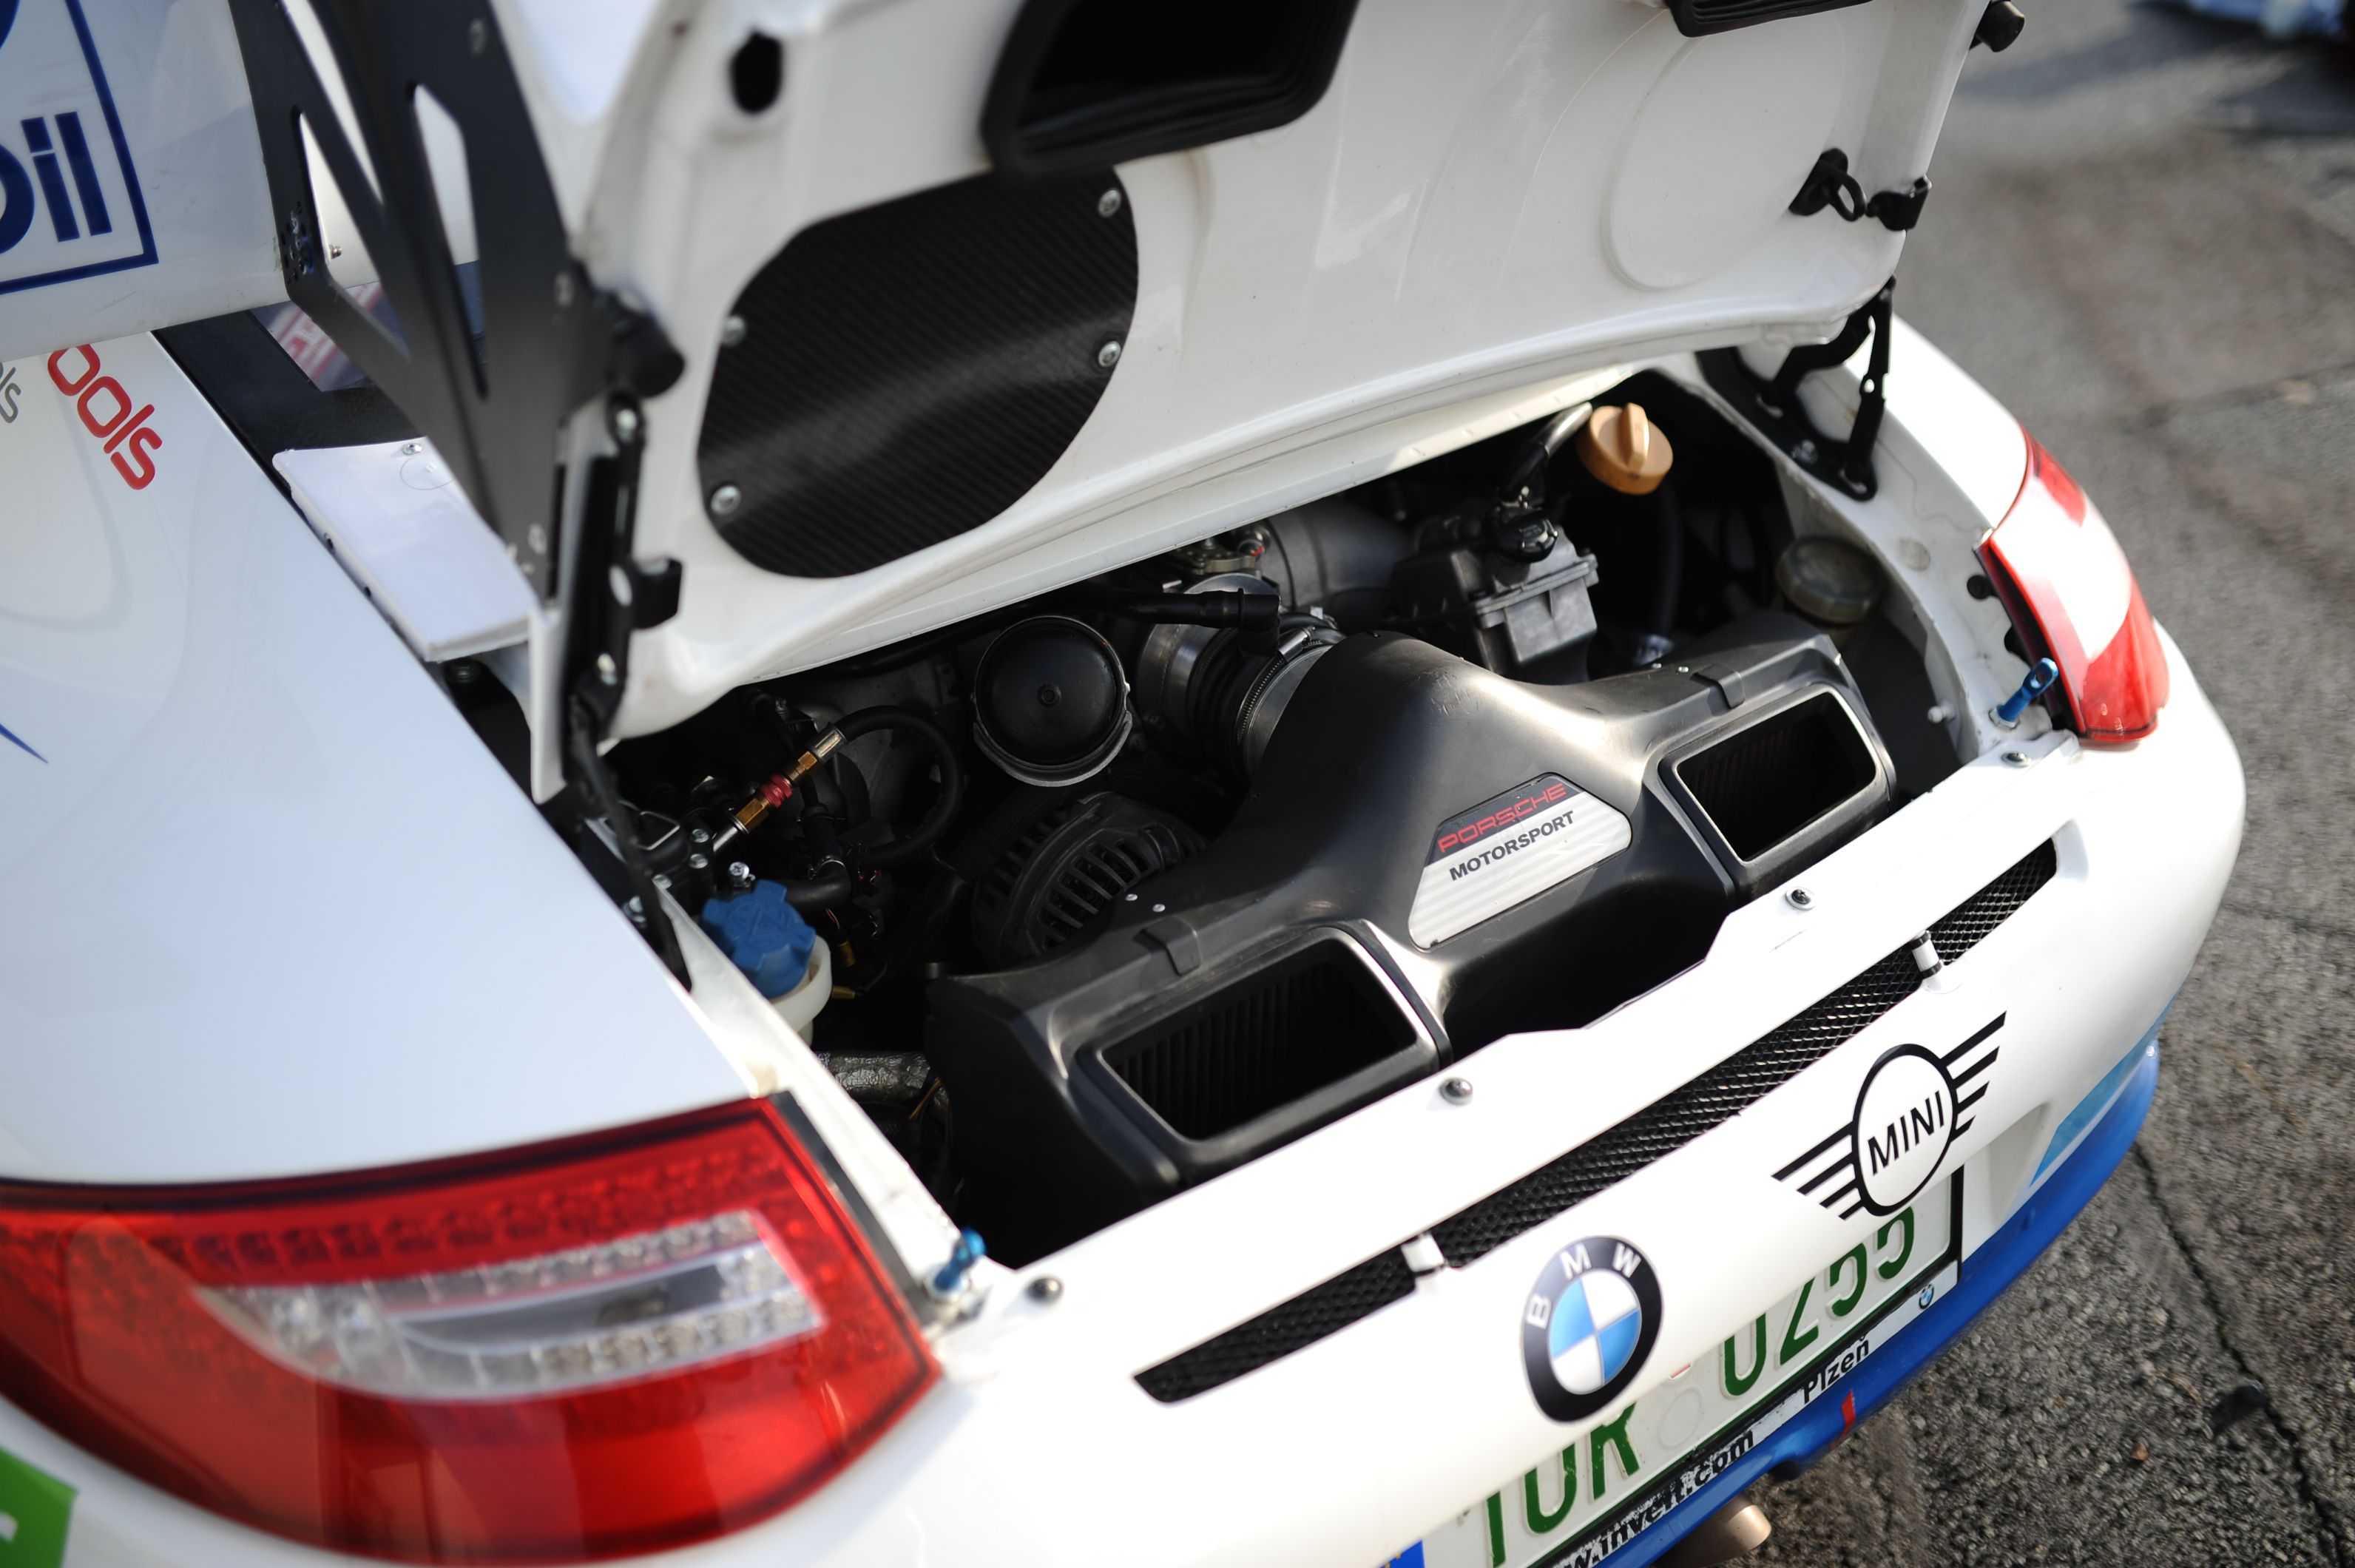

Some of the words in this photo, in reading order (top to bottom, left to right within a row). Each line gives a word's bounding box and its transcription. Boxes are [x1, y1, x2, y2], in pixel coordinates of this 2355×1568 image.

[1437, 783, 1567, 853] PORSCHE
[1449, 811, 1574, 881] MOTORSPORT
[1868, 1090, 1945, 1176] MINI
[1527, 1243, 1642, 1330] BMW
[1803, 1335, 1869, 1405] Plzeň
